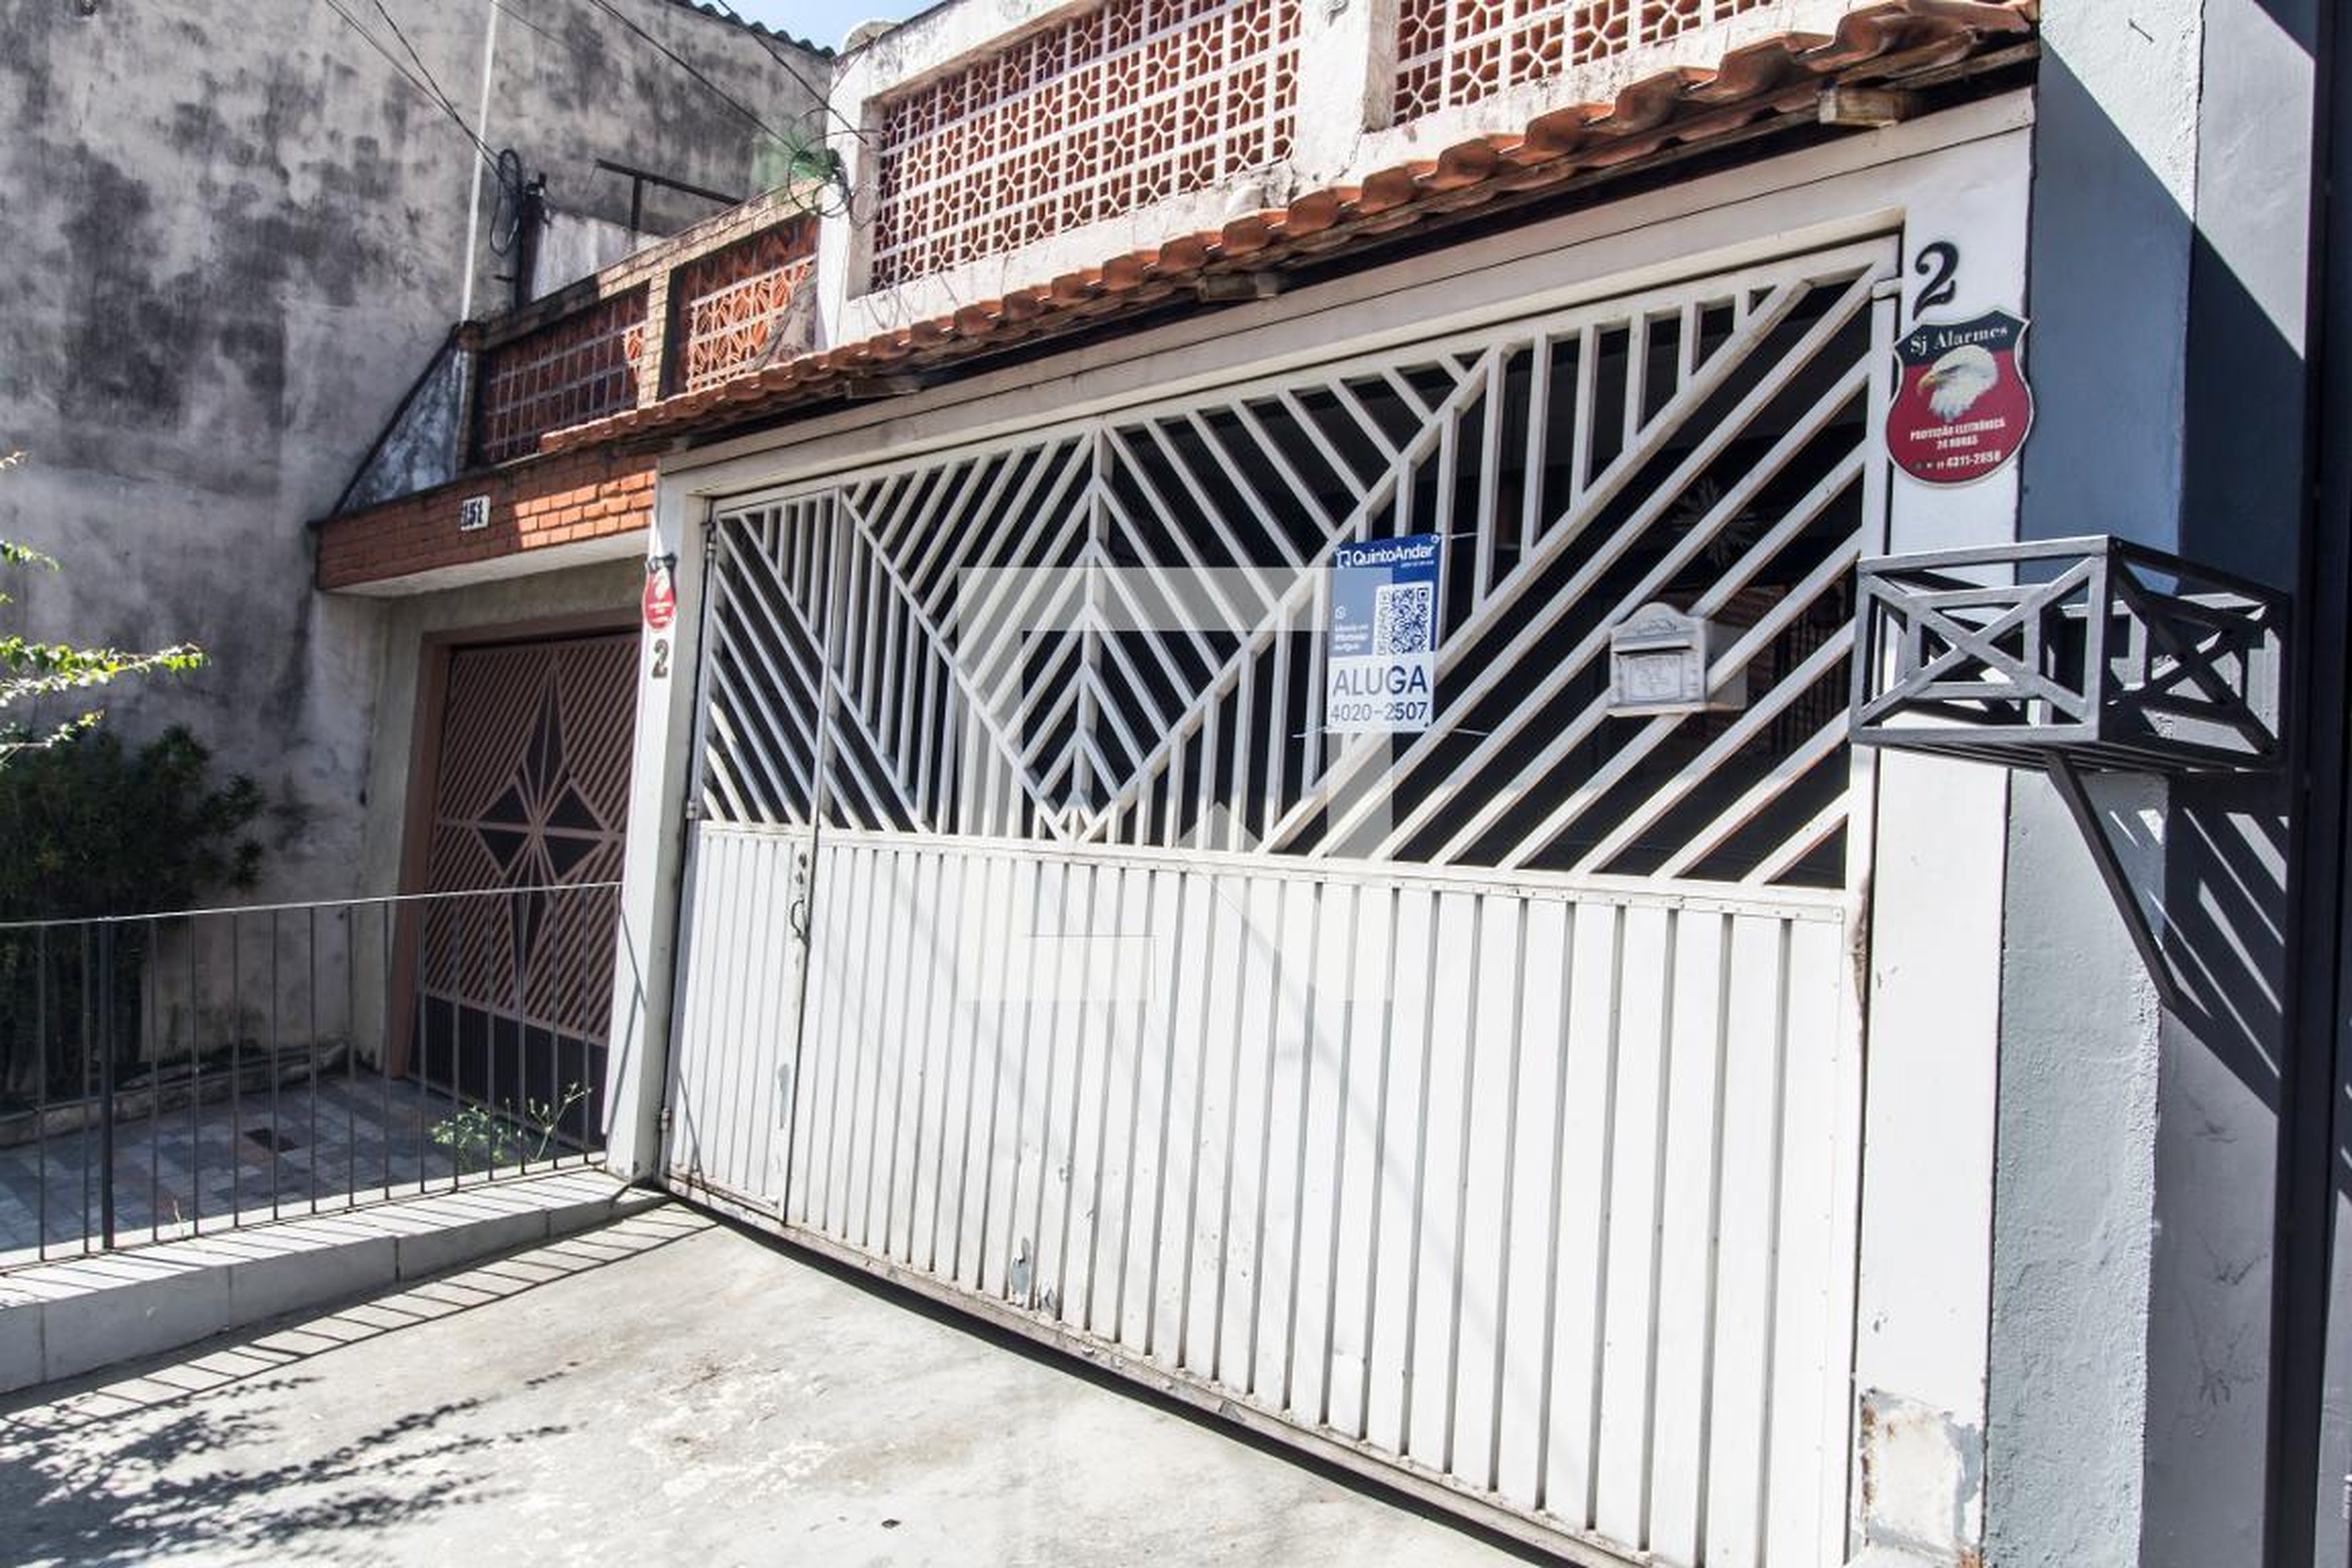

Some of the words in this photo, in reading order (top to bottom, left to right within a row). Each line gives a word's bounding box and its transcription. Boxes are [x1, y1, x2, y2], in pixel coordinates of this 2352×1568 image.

[1913, 241, 1959, 321] 2
[1910, 334, 1928, 356] Sj
[1934, 326, 2008, 350] Alarmes
[1352, 543, 1435, 566] QuintoAndar
[651, 639, 668, 679] 2
[1332, 663, 1428, 697] ALUGA
[1330, 701, 1428, 722] 4020-2507
